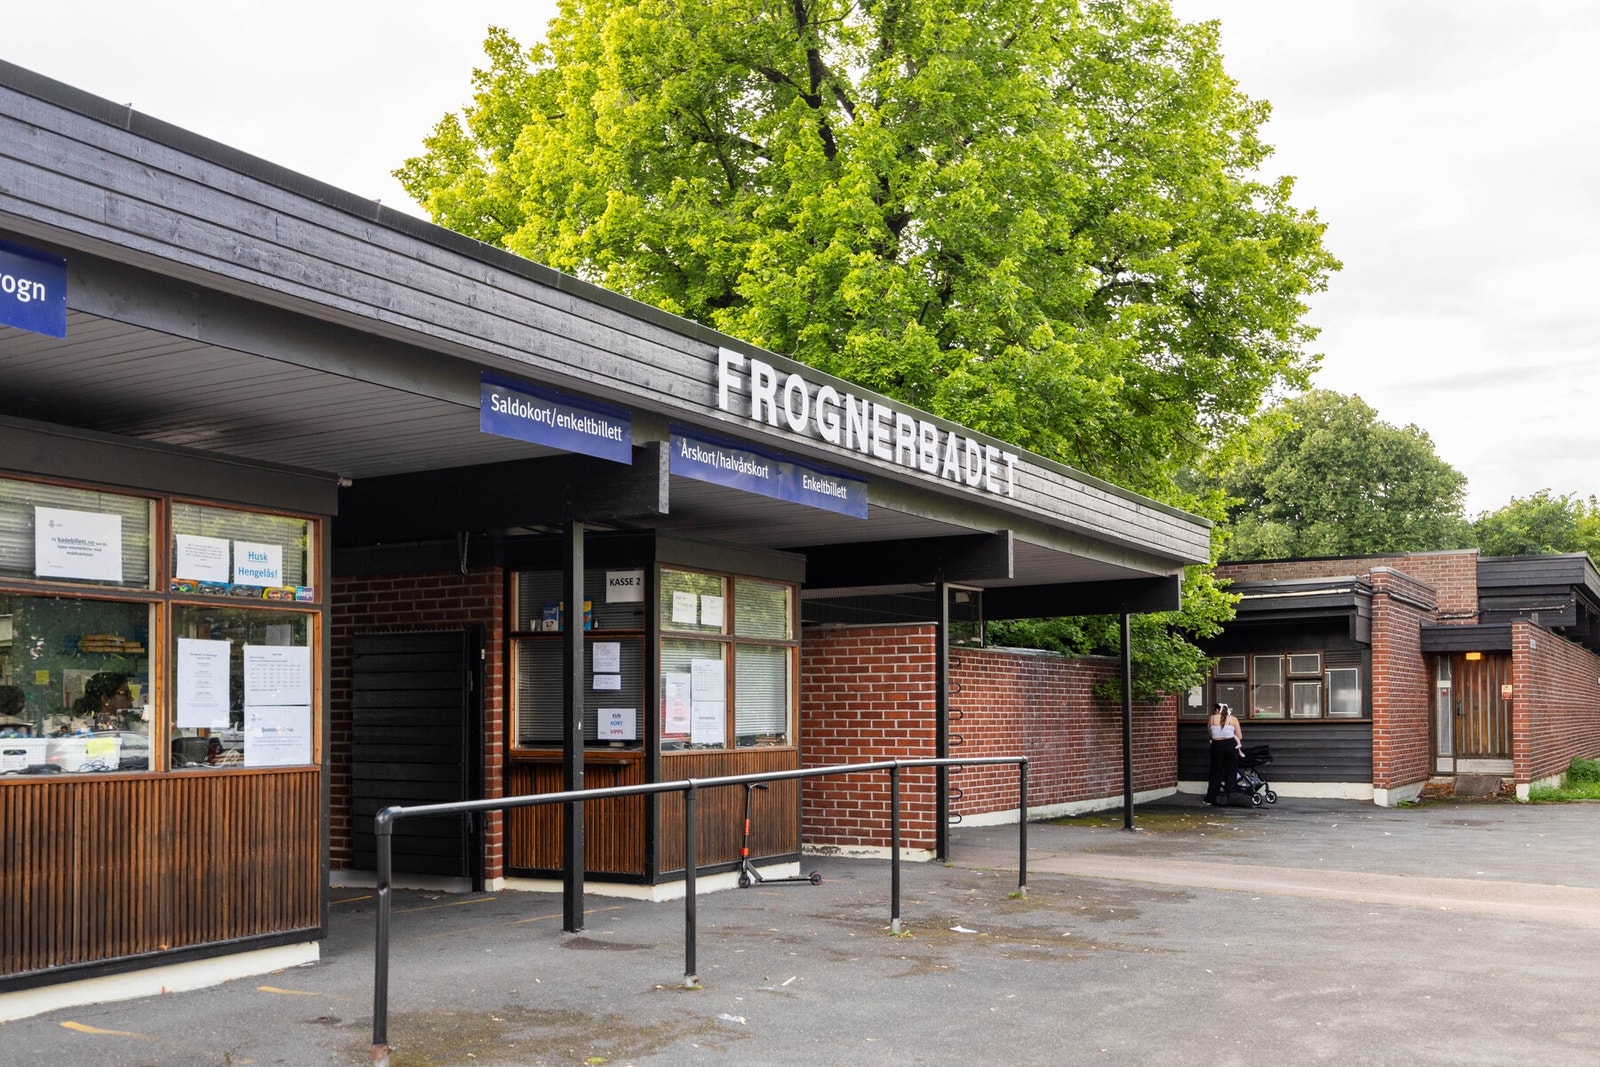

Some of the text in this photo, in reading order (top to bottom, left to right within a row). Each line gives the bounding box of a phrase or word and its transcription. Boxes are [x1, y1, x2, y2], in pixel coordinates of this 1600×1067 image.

[0, 273, 46, 303] ogn
[490, 393, 623, 442] Saldokort/enkeltbillett
[718, 346, 1018, 498] FROGNERBADET
[681, 438, 769, 480] Årskort/halvårskort
[803, 475, 847, 500] Enkeltbillett
[248, 551, 268, 562] Husk
[238, 567, 278, 579] Hengelås!
[609, 577, 641, 587] KASSE 2
